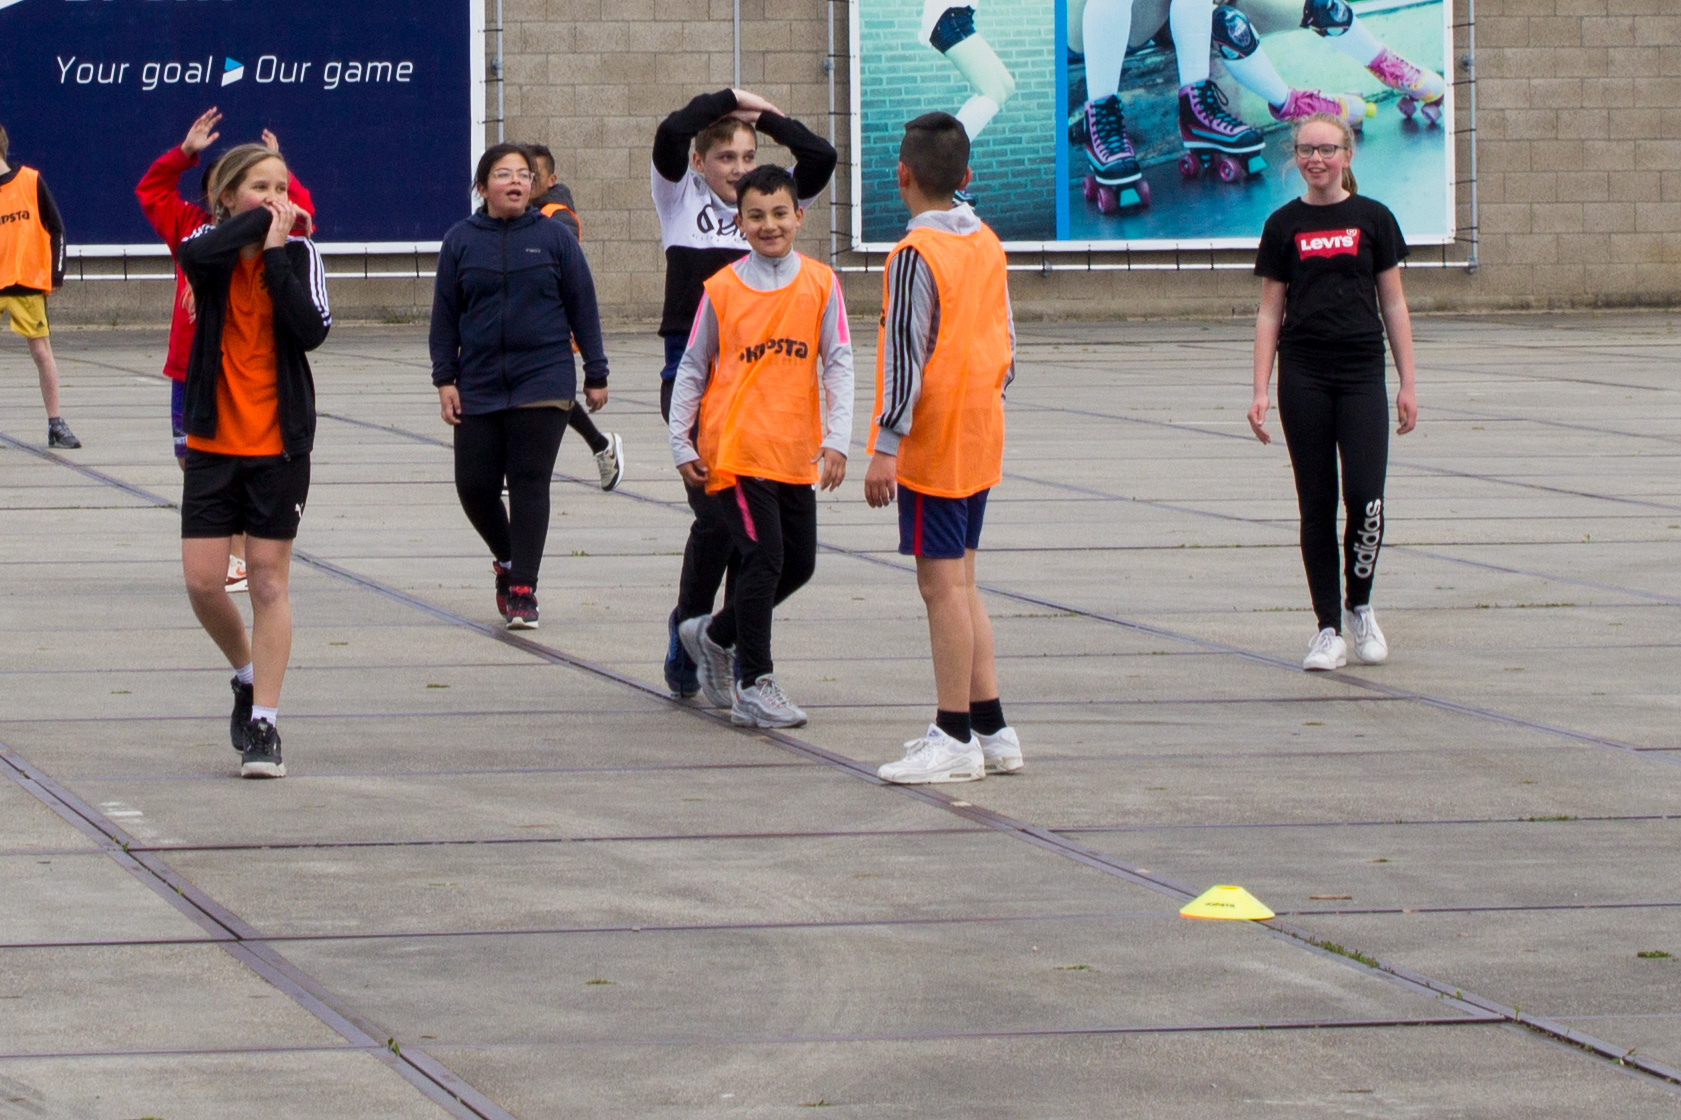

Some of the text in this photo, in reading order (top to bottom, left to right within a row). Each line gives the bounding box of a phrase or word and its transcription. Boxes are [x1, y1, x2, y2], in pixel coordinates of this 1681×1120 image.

[56, 55, 414, 91] Your goal Our game
[1353, 498, 1381, 578] adidas
